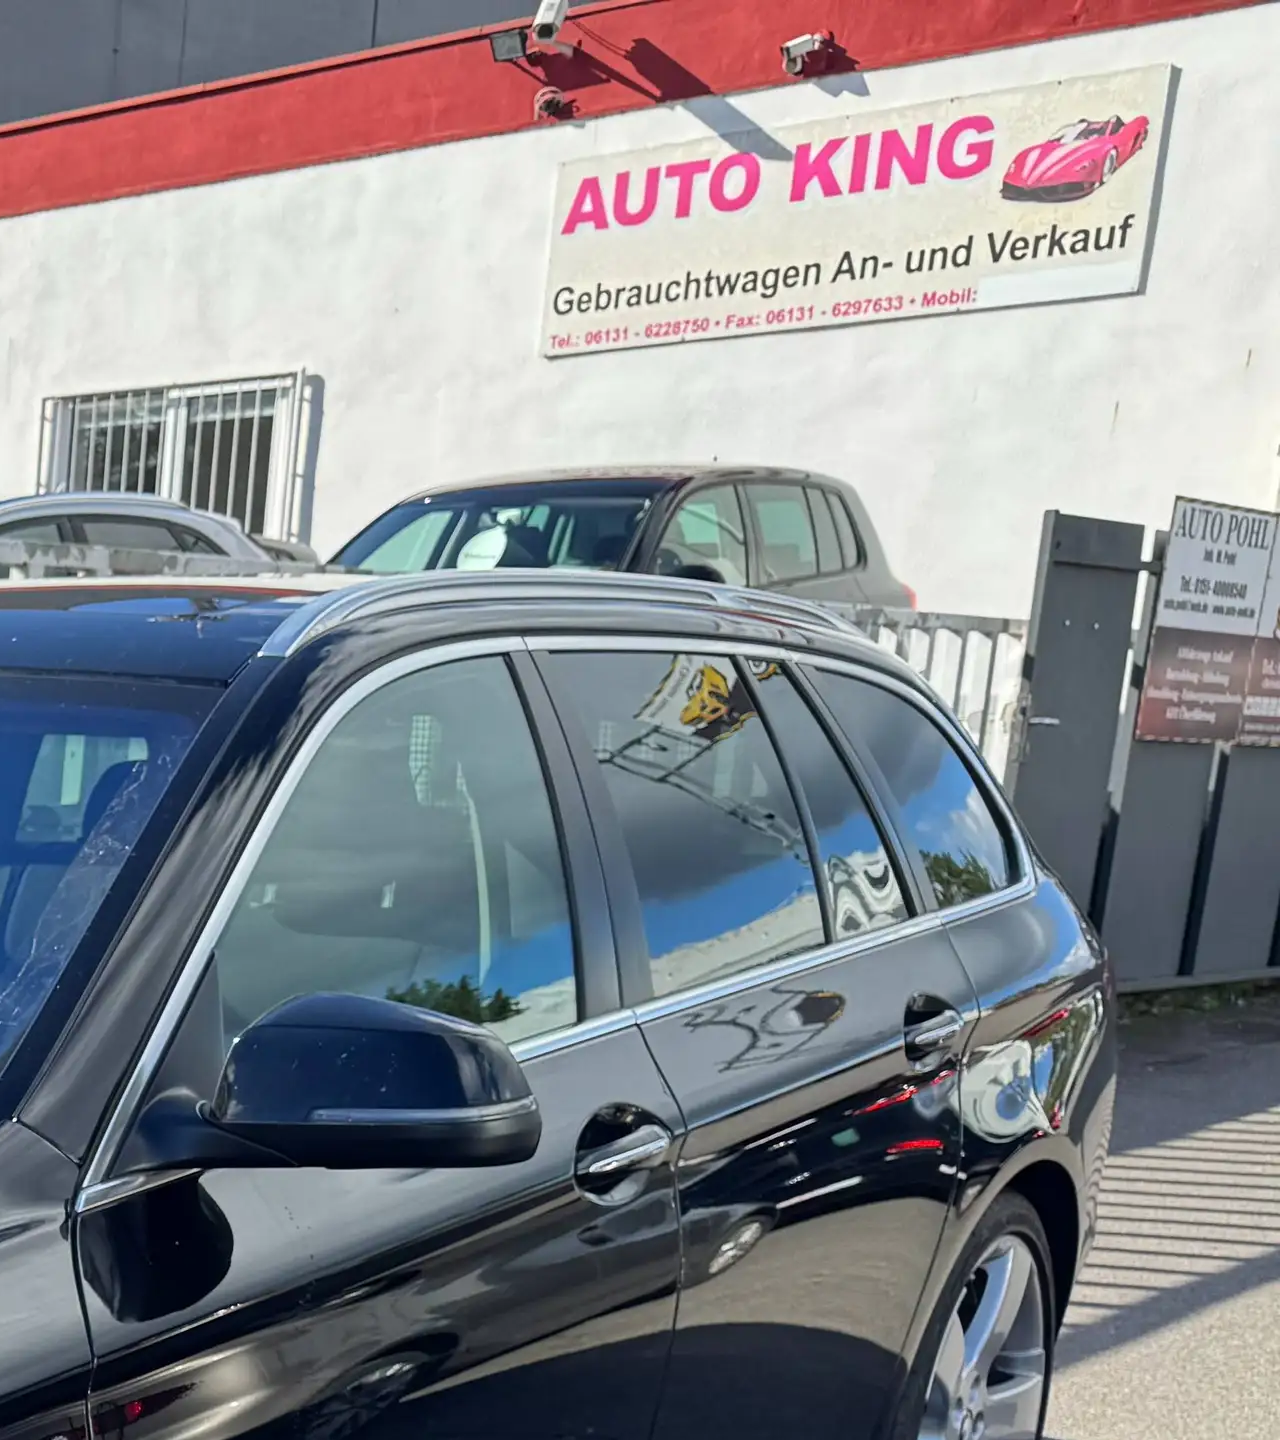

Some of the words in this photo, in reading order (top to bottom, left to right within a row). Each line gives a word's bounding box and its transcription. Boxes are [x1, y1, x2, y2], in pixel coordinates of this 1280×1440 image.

[561, 152, 761, 235] AUTO
[789, 115, 995, 203] KING
[553, 260, 822, 316] Gebrauchtwagen
[831, 250, 893, 283] An-
[905, 235, 974, 274] und
[988, 214, 1135, 263] Verkauf
[584, 328, 629, 346] 06131
[725, 312, 761, 328] Fax:
[766, 304, 815, 325] 06131
[831, 295, 904, 318] 6297633
[921, 287, 977, 308] Mobil:
[1175, 506, 1223, 544] AUTO
[1224, 513, 1269, 550] POHL
